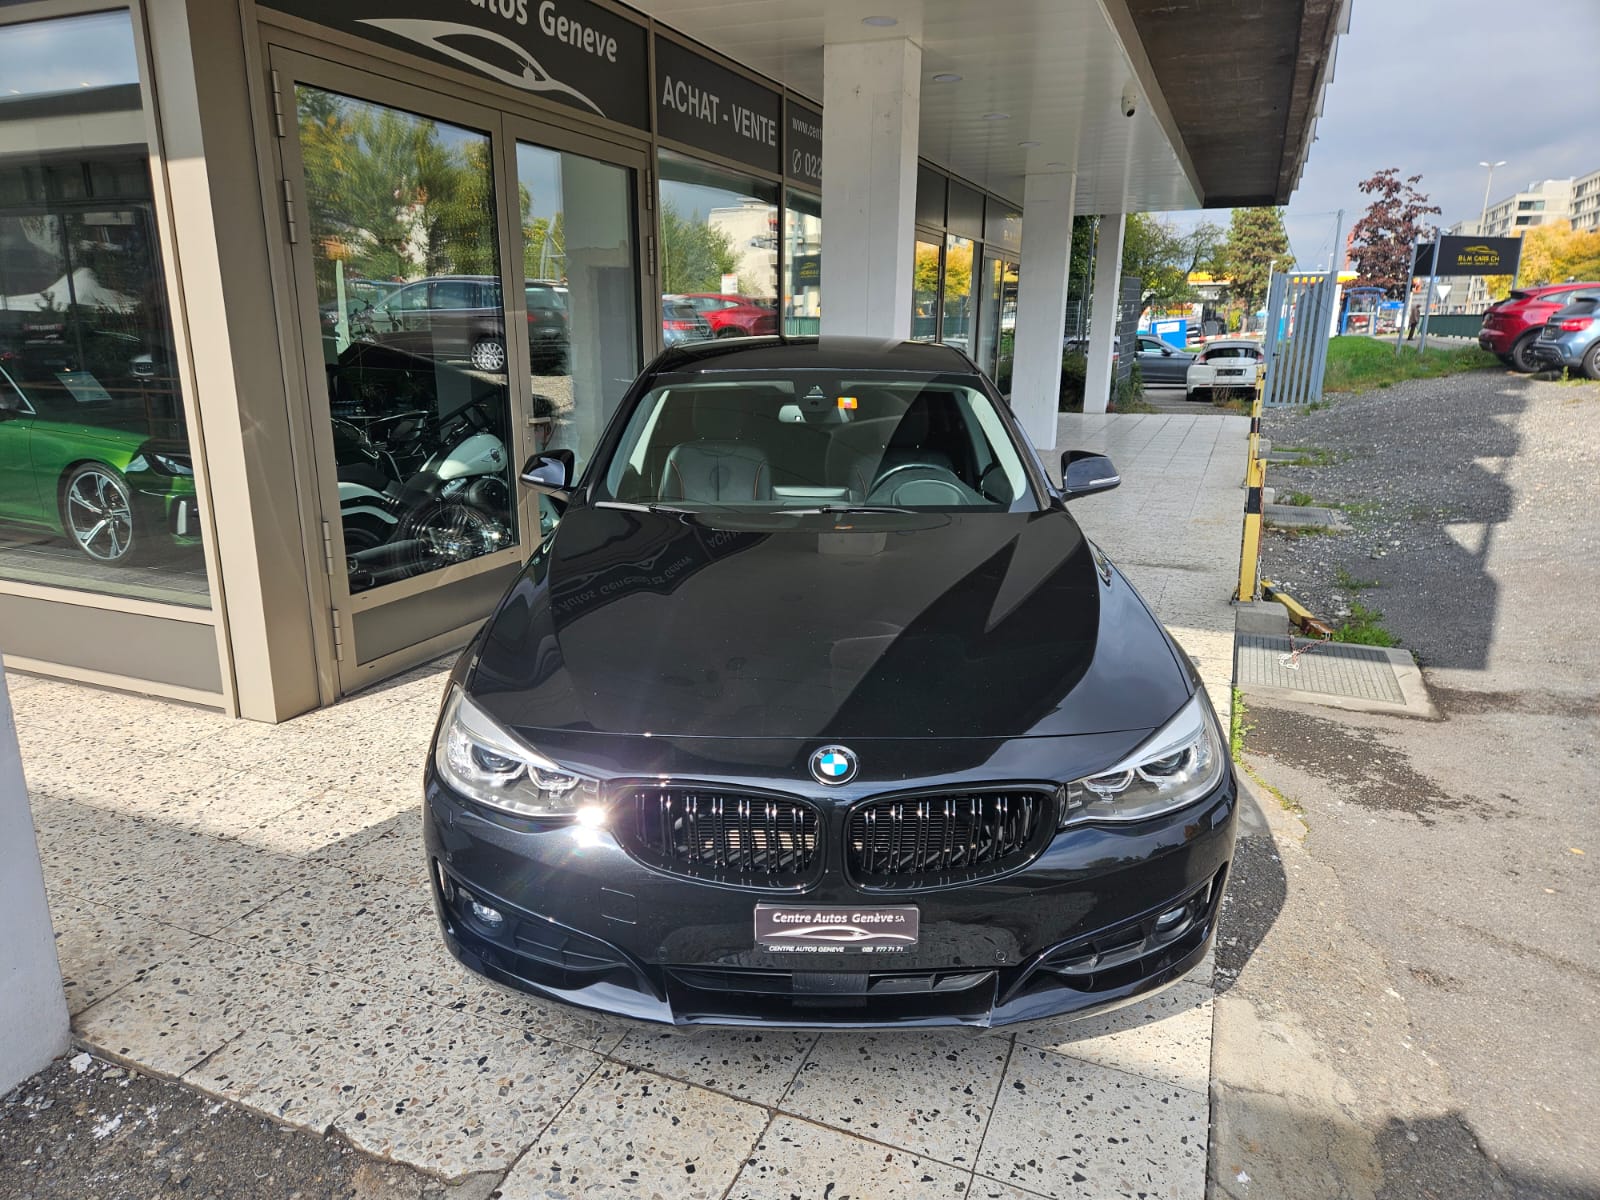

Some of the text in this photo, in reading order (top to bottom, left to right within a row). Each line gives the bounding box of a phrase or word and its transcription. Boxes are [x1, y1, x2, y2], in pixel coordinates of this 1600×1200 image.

[538, 1, 617, 63] Geneve
[662, 75, 720, 125] ACHAT
[732, 104, 776, 147] VENTE
[772, 912, 905, 923] Centre Autos Genève SA
[768, 945, 795, 953] CENTRE
[795, 945, 817, 953] AUTOS
